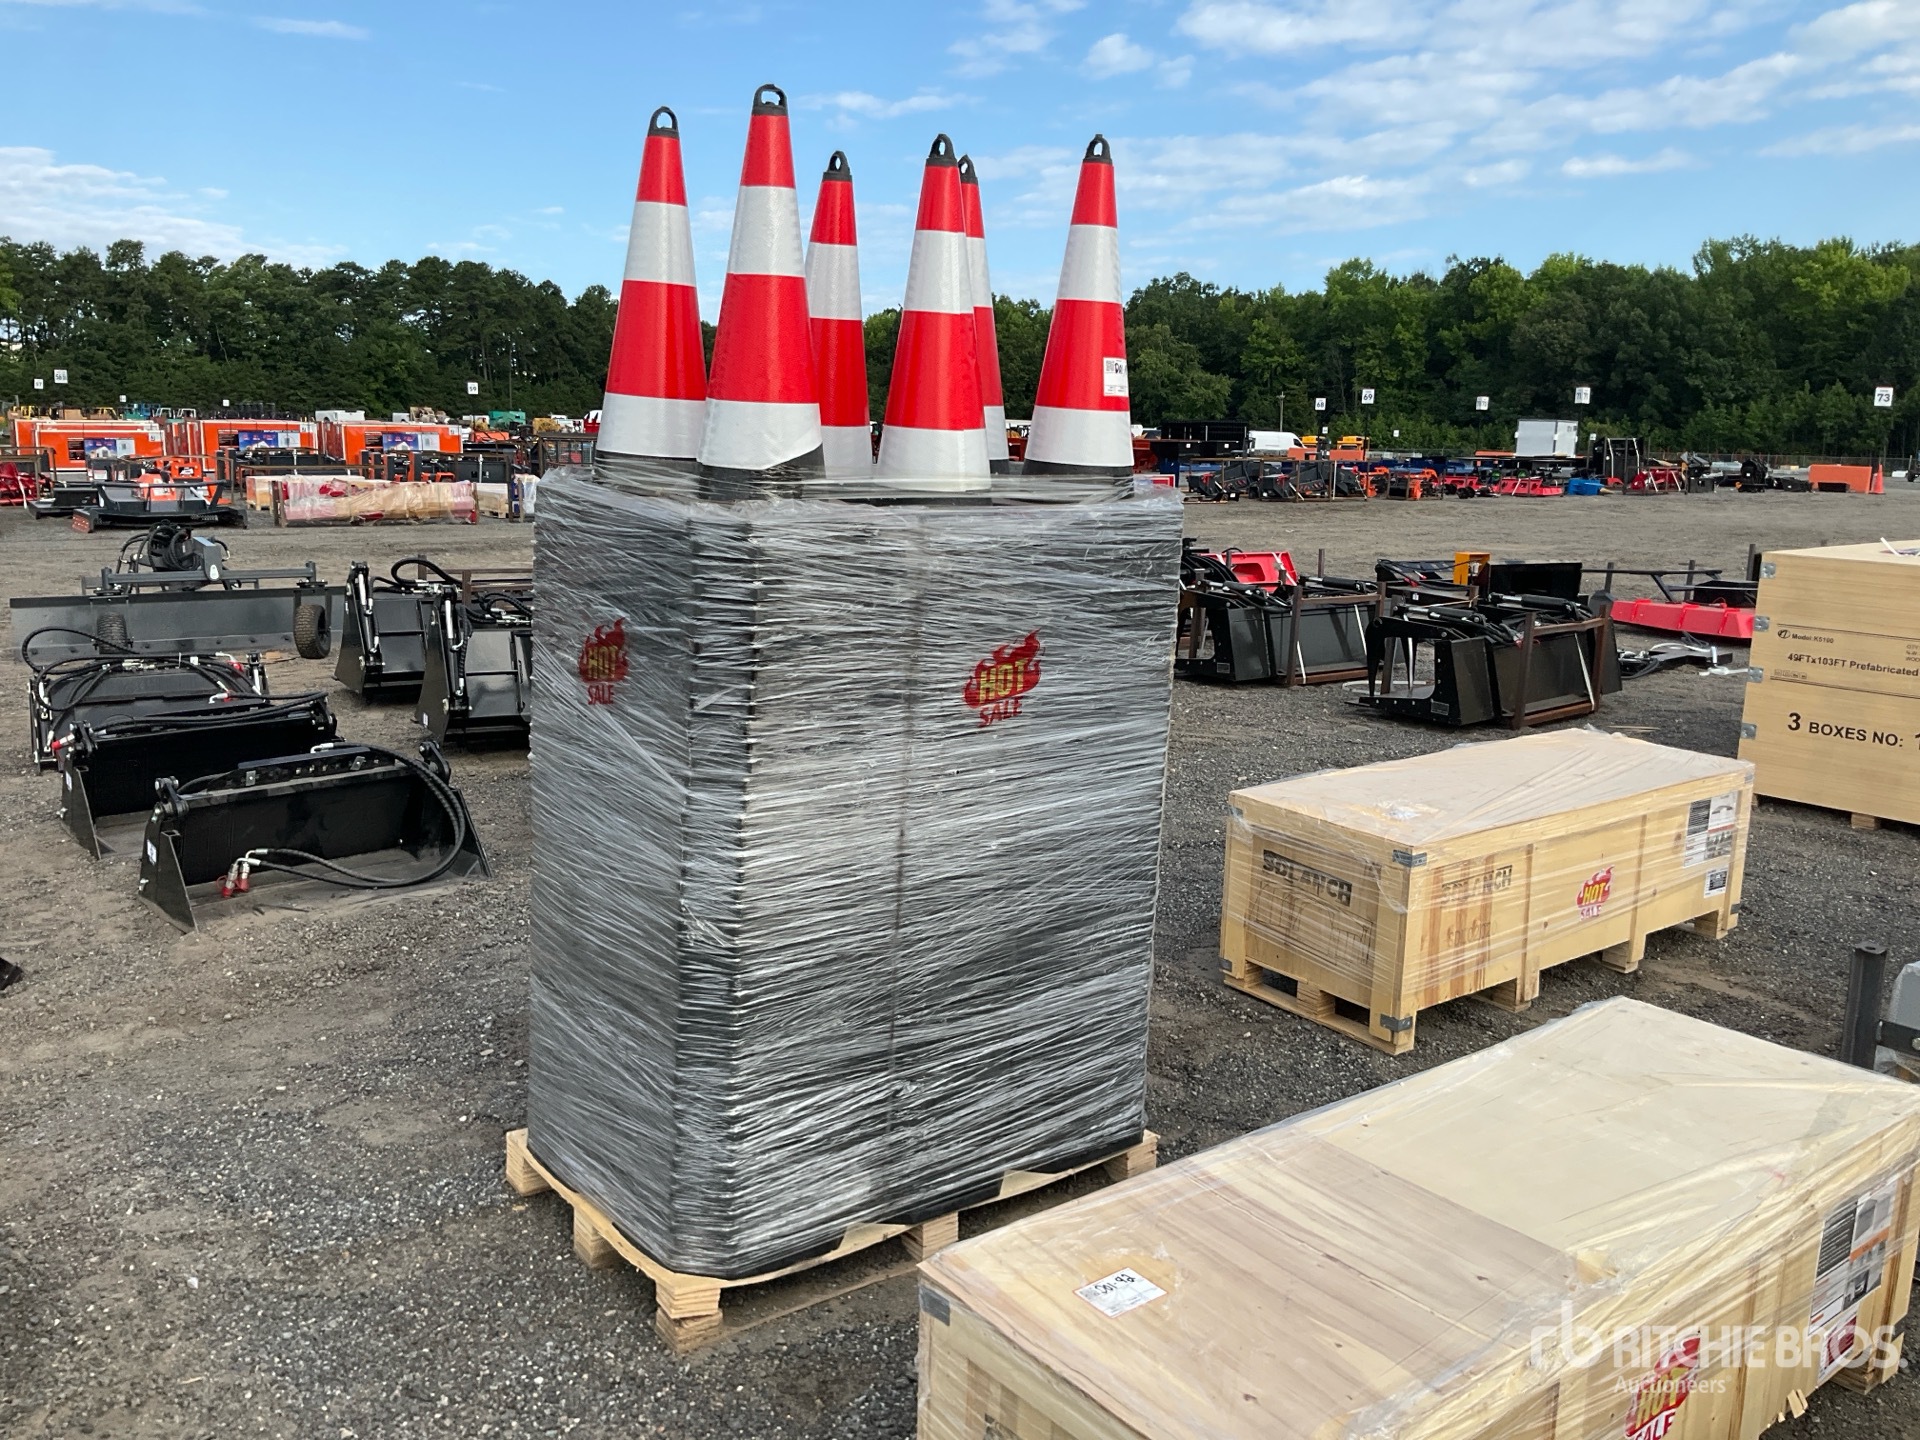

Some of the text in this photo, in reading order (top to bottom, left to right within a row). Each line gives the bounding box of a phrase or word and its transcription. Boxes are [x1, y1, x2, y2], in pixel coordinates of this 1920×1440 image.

[1363, 393, 1373, 401] 69
[1877, 393, 1891, 403] 73
[587, 645, 619, 680] HOT
[1787, 652, 1919, 677] 49FTx103FT Prefabricated
[587, 684, 615, 705] SALE
[979, 658, 1029, 704] HOT
[977, 695, 1023, 728] SALE
[1787, 712, 1801, 731] 3
[1808, 721, 1868, 742] BOXES
[1872, 730, 1904, 748] NO:
[1582, 882, 1607, 905] HOT
[1635, 1367, 1690, 1431] HOT
